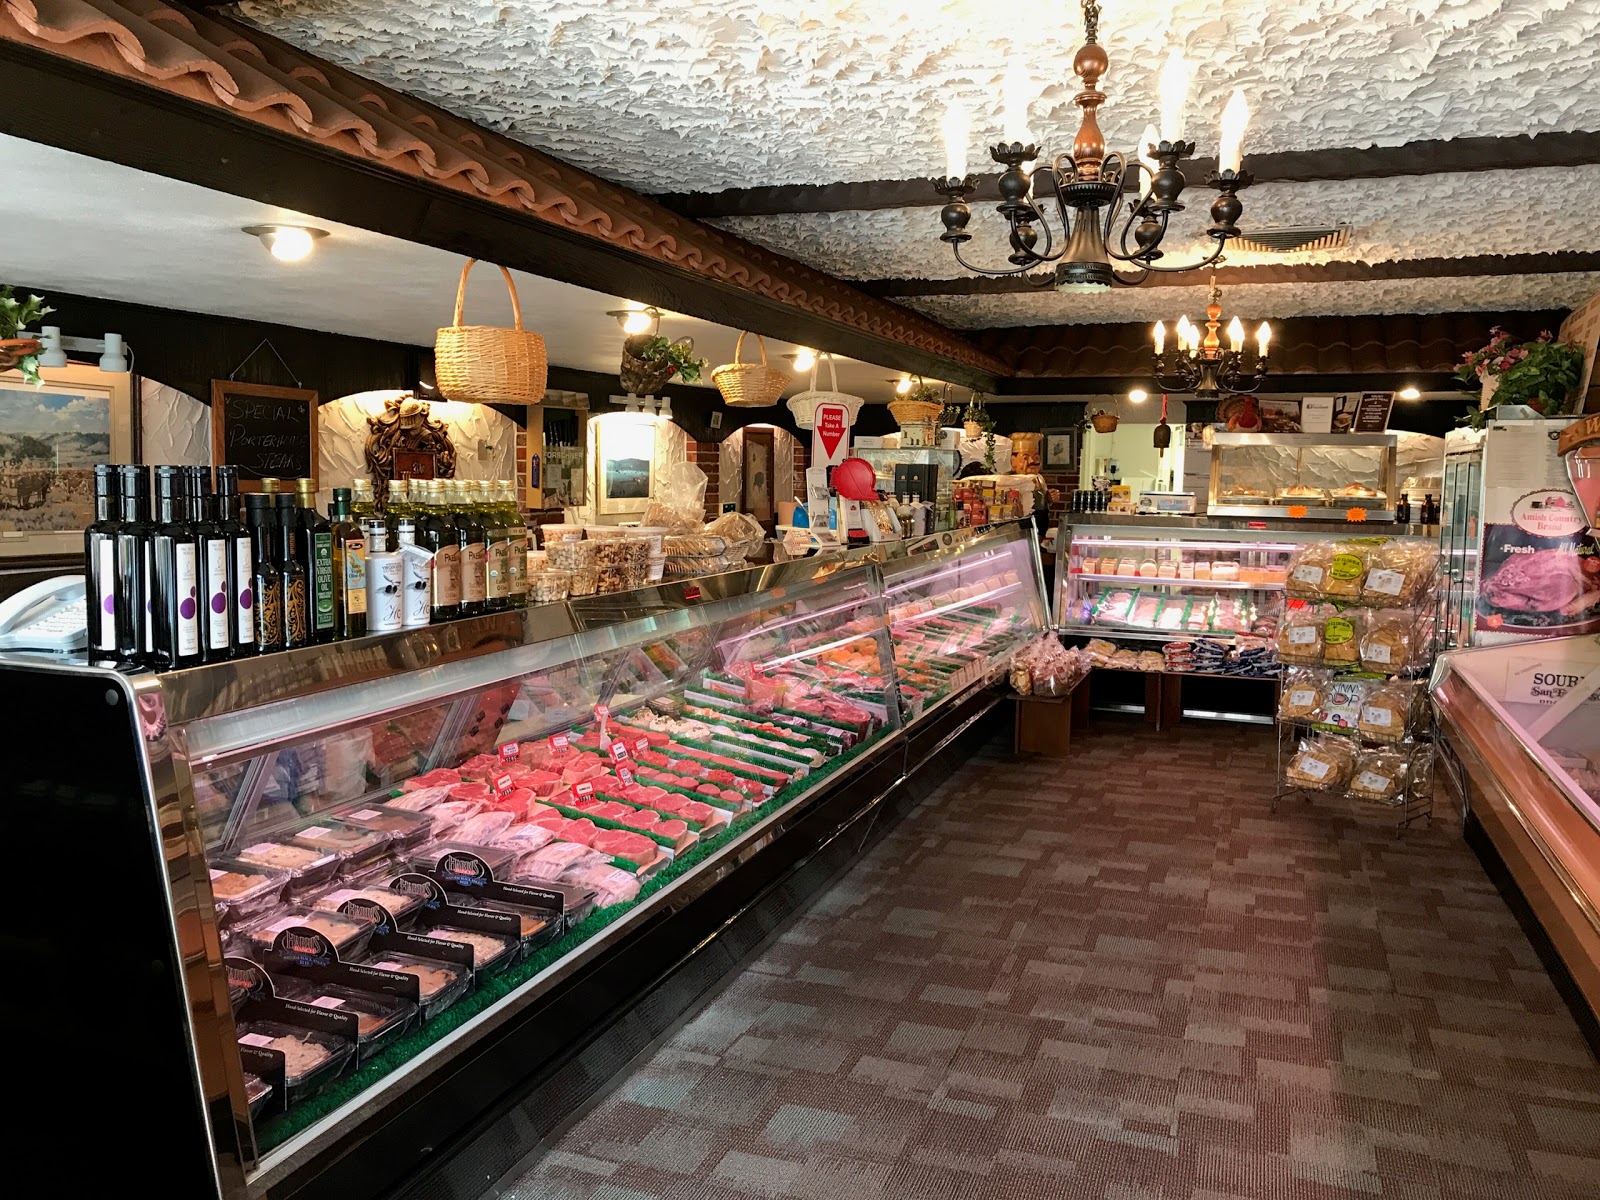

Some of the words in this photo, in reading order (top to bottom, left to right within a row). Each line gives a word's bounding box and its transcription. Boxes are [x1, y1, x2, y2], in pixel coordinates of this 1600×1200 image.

[228, 400, 300, 423] SPECIAL
[1522, 513, 1547, 521] Amish
[1548, 514, 1582, 525] Country
[1537, 521, 1562, 530] Brand
[1503, 543, 1536, 554] Fresh
[320, 583, 329, 591] OIL
[1533, 672, 1585, 689] SOUR
[395, 973, 409, 981] Quality
[334, 1012, 348, 1021] Quality
[258, 1050, 274, 1058] Quality
